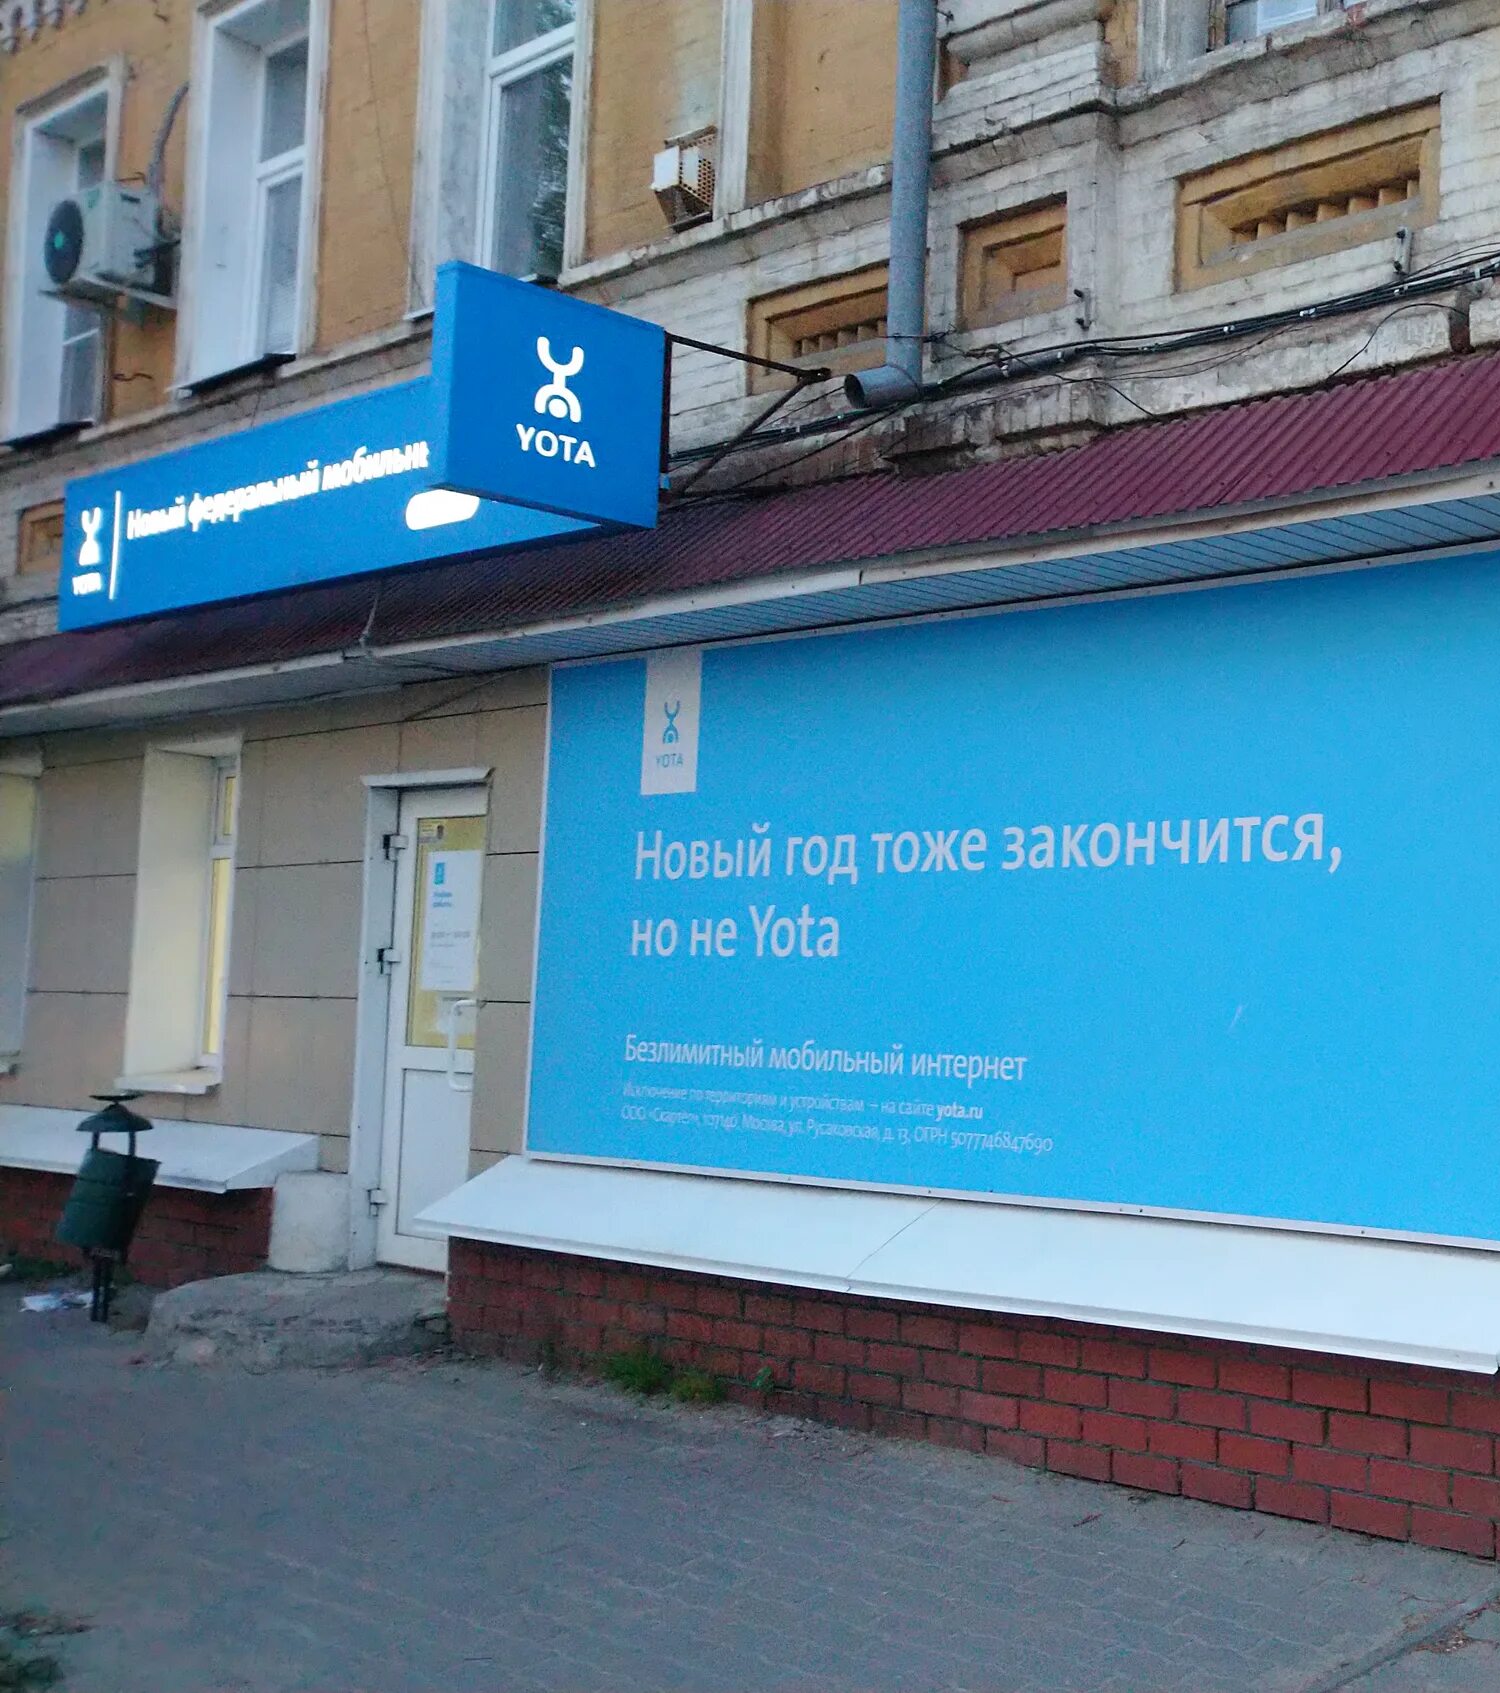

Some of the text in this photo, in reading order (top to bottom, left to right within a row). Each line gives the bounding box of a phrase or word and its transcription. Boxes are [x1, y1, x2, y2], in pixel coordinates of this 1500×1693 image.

[516, 423, 595, 468] YOTA
[126, 495, 186, 540] Новый
[656, 753, 685, 768] YOTA
[635, 812, 1343, 885] Новый год тоже закончится,
[631, 903, 840, 958] но не Yota
[624, 1034, 1028, 1089] Безлимитный мобильный интернет
[898, 1099, 933, 1117] сайте
[935, 1101, 984, 1121] yota.ru
[914, 1126, 948, 1144] ОГРН
